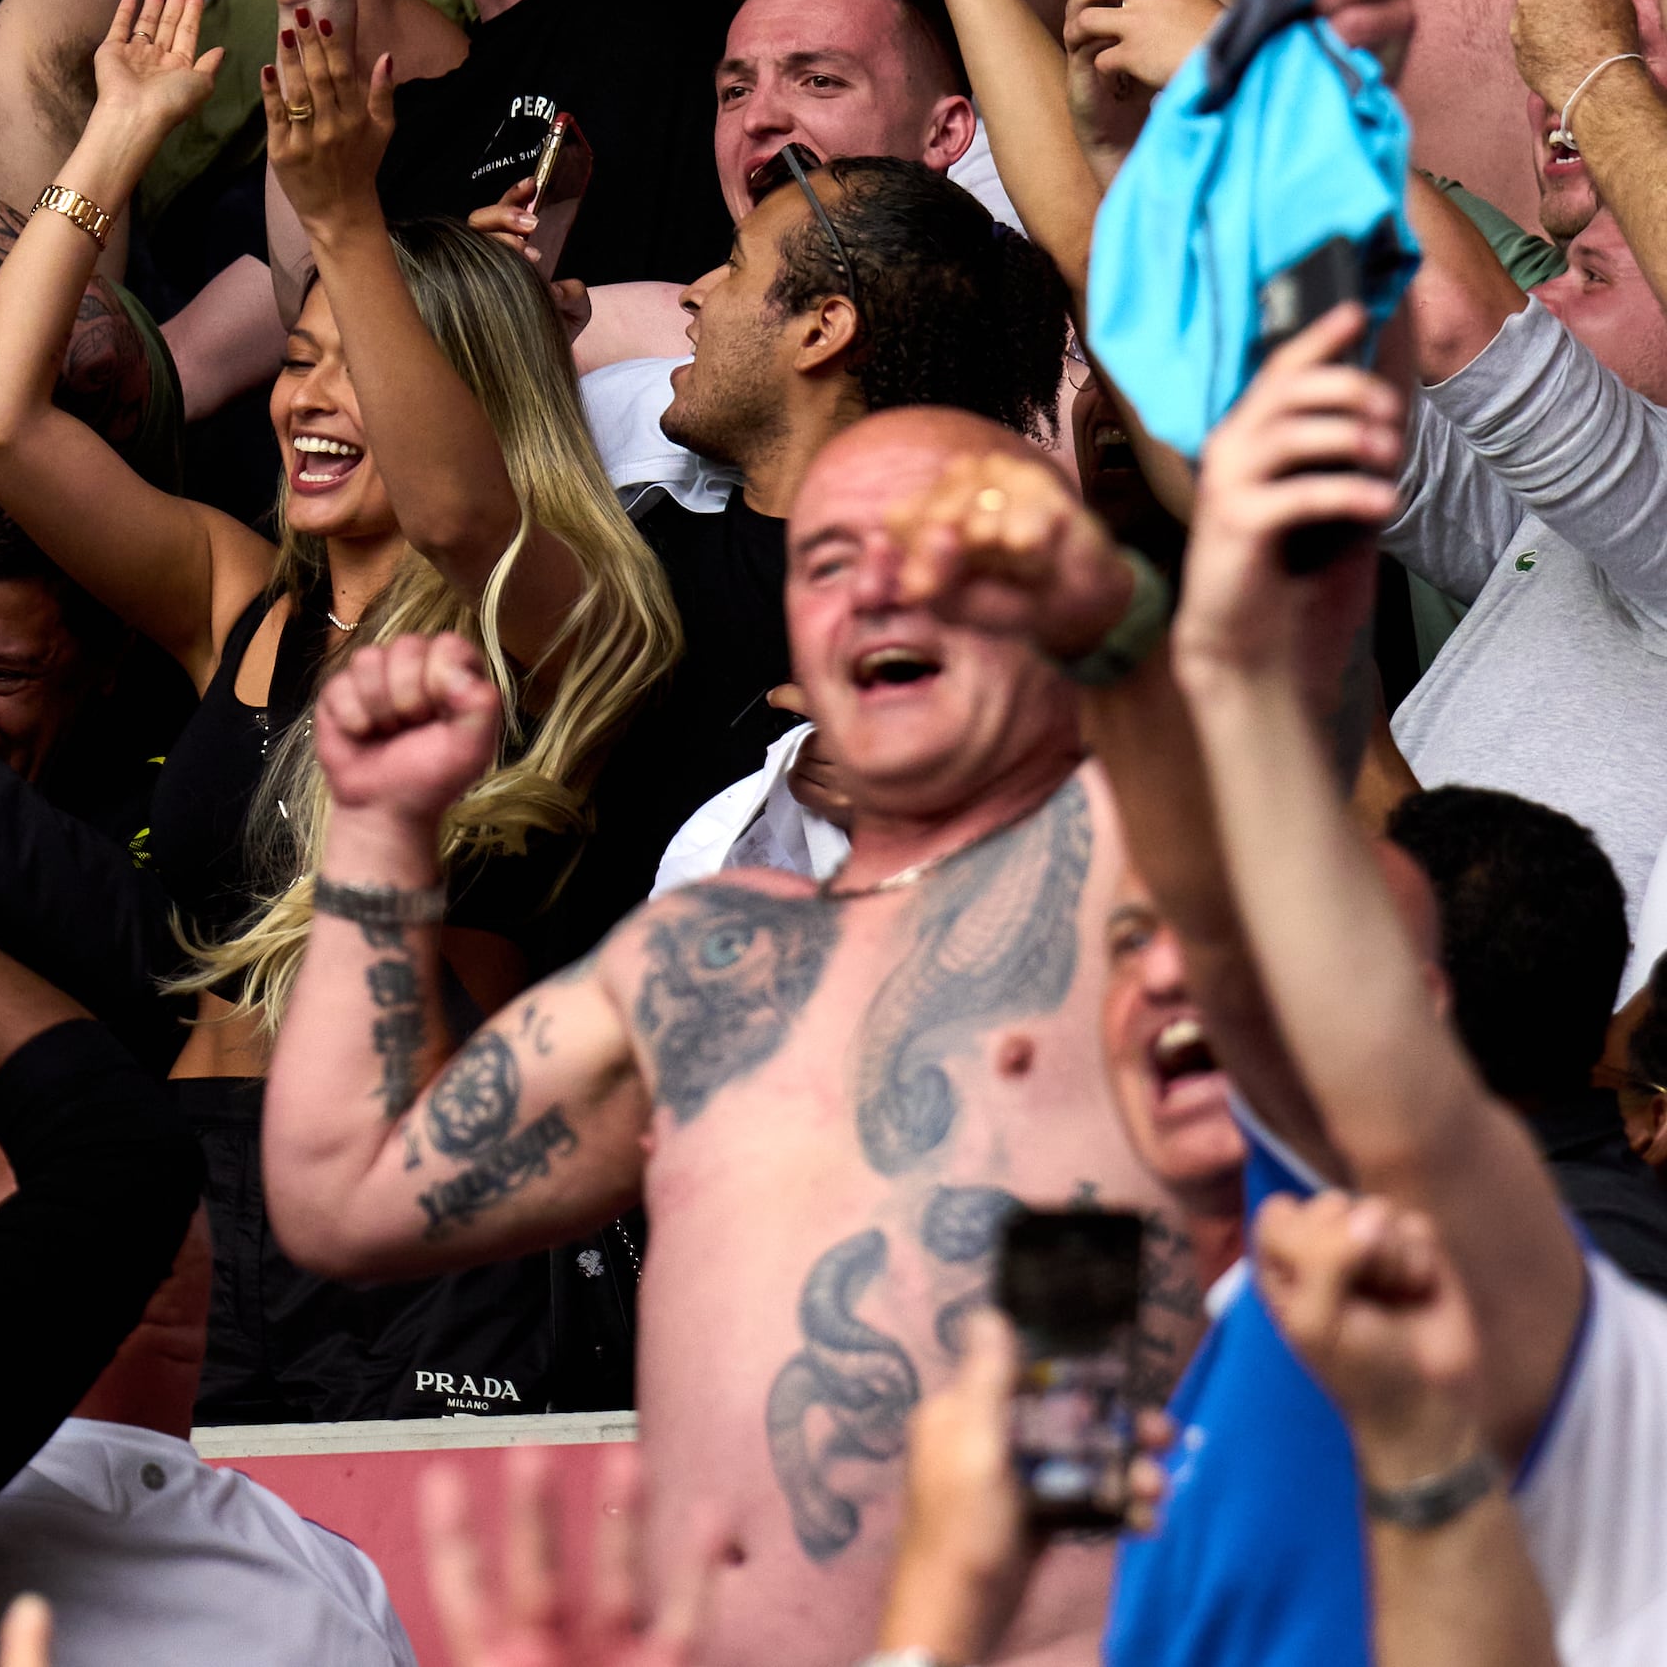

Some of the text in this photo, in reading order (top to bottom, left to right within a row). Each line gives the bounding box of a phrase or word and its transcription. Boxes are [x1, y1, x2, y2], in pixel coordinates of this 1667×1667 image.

[472, 156, 516, 179] ORIGINAL
[415, 1370, 522, 1402] PRADA
[447, 1397, 489, 1411] MILANO
